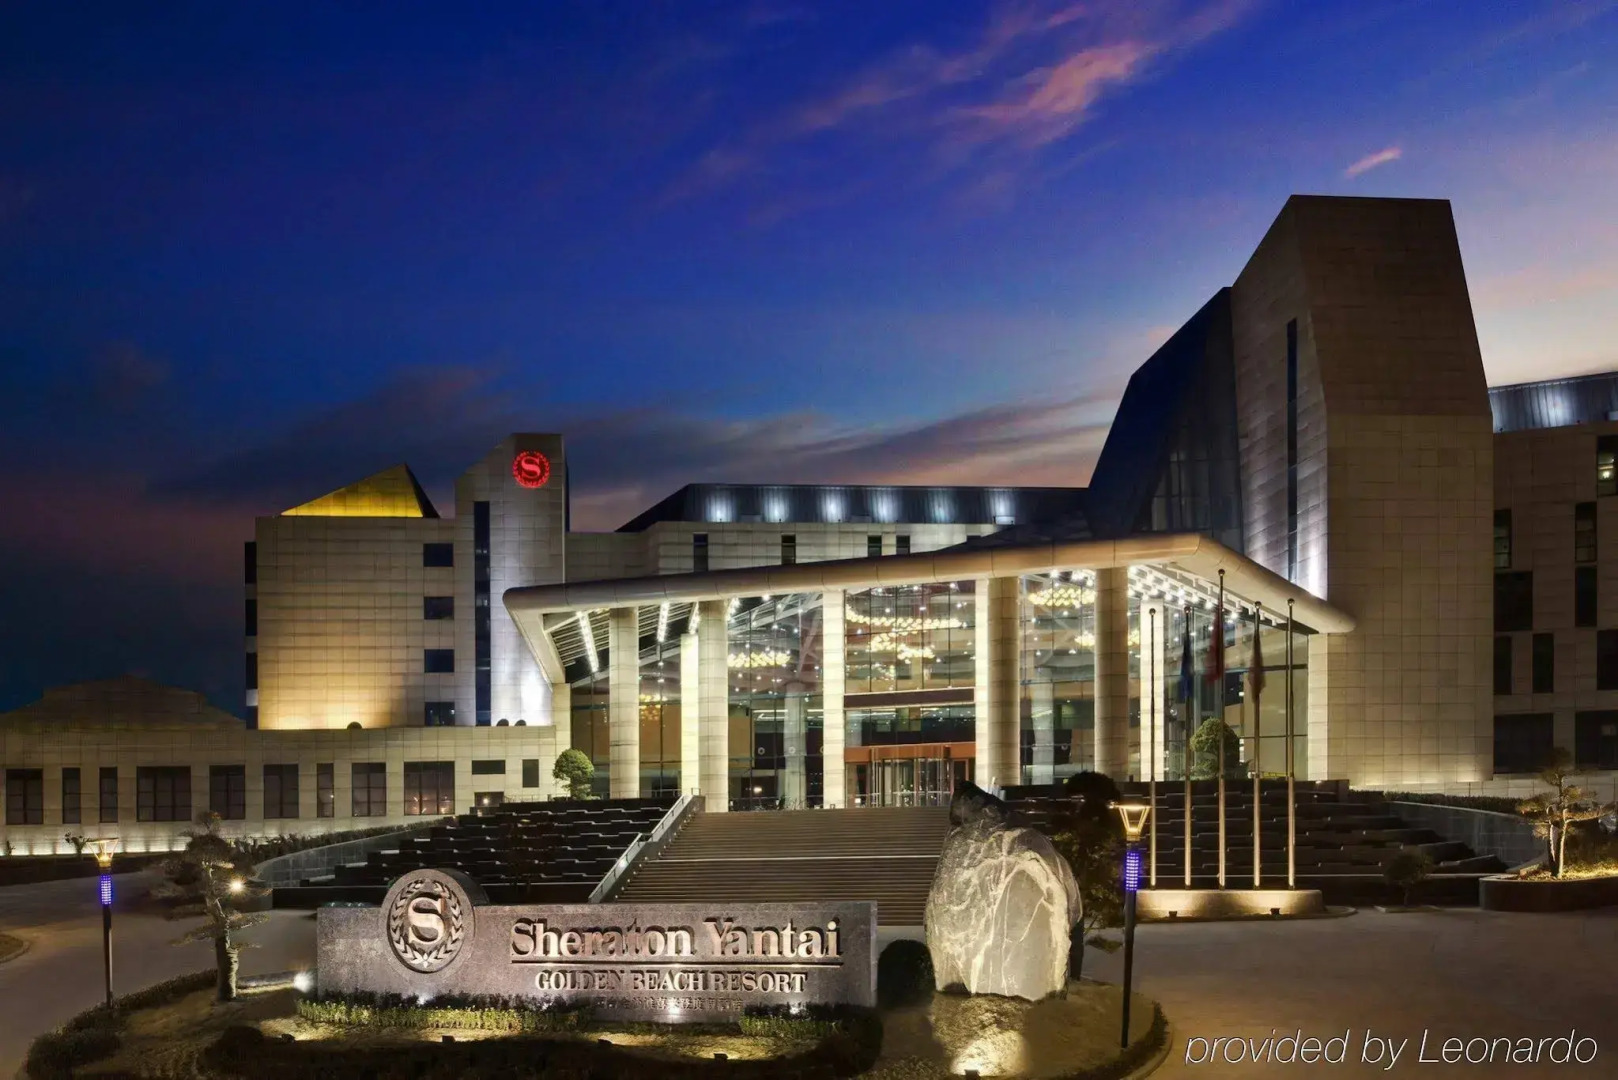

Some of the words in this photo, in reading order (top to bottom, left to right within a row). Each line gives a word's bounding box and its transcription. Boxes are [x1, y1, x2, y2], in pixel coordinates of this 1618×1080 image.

[521, 456, 540, 479] S
[408, 897, 444, 944] S
[511, 919, 694, 958] Sheraton
[702, 918, 843, 958] Yantai
[535, 971, 624, 991] GOLDEN
[631, 971, 706, 991] BEACH
[711, 972, 807, 993] RESORT
